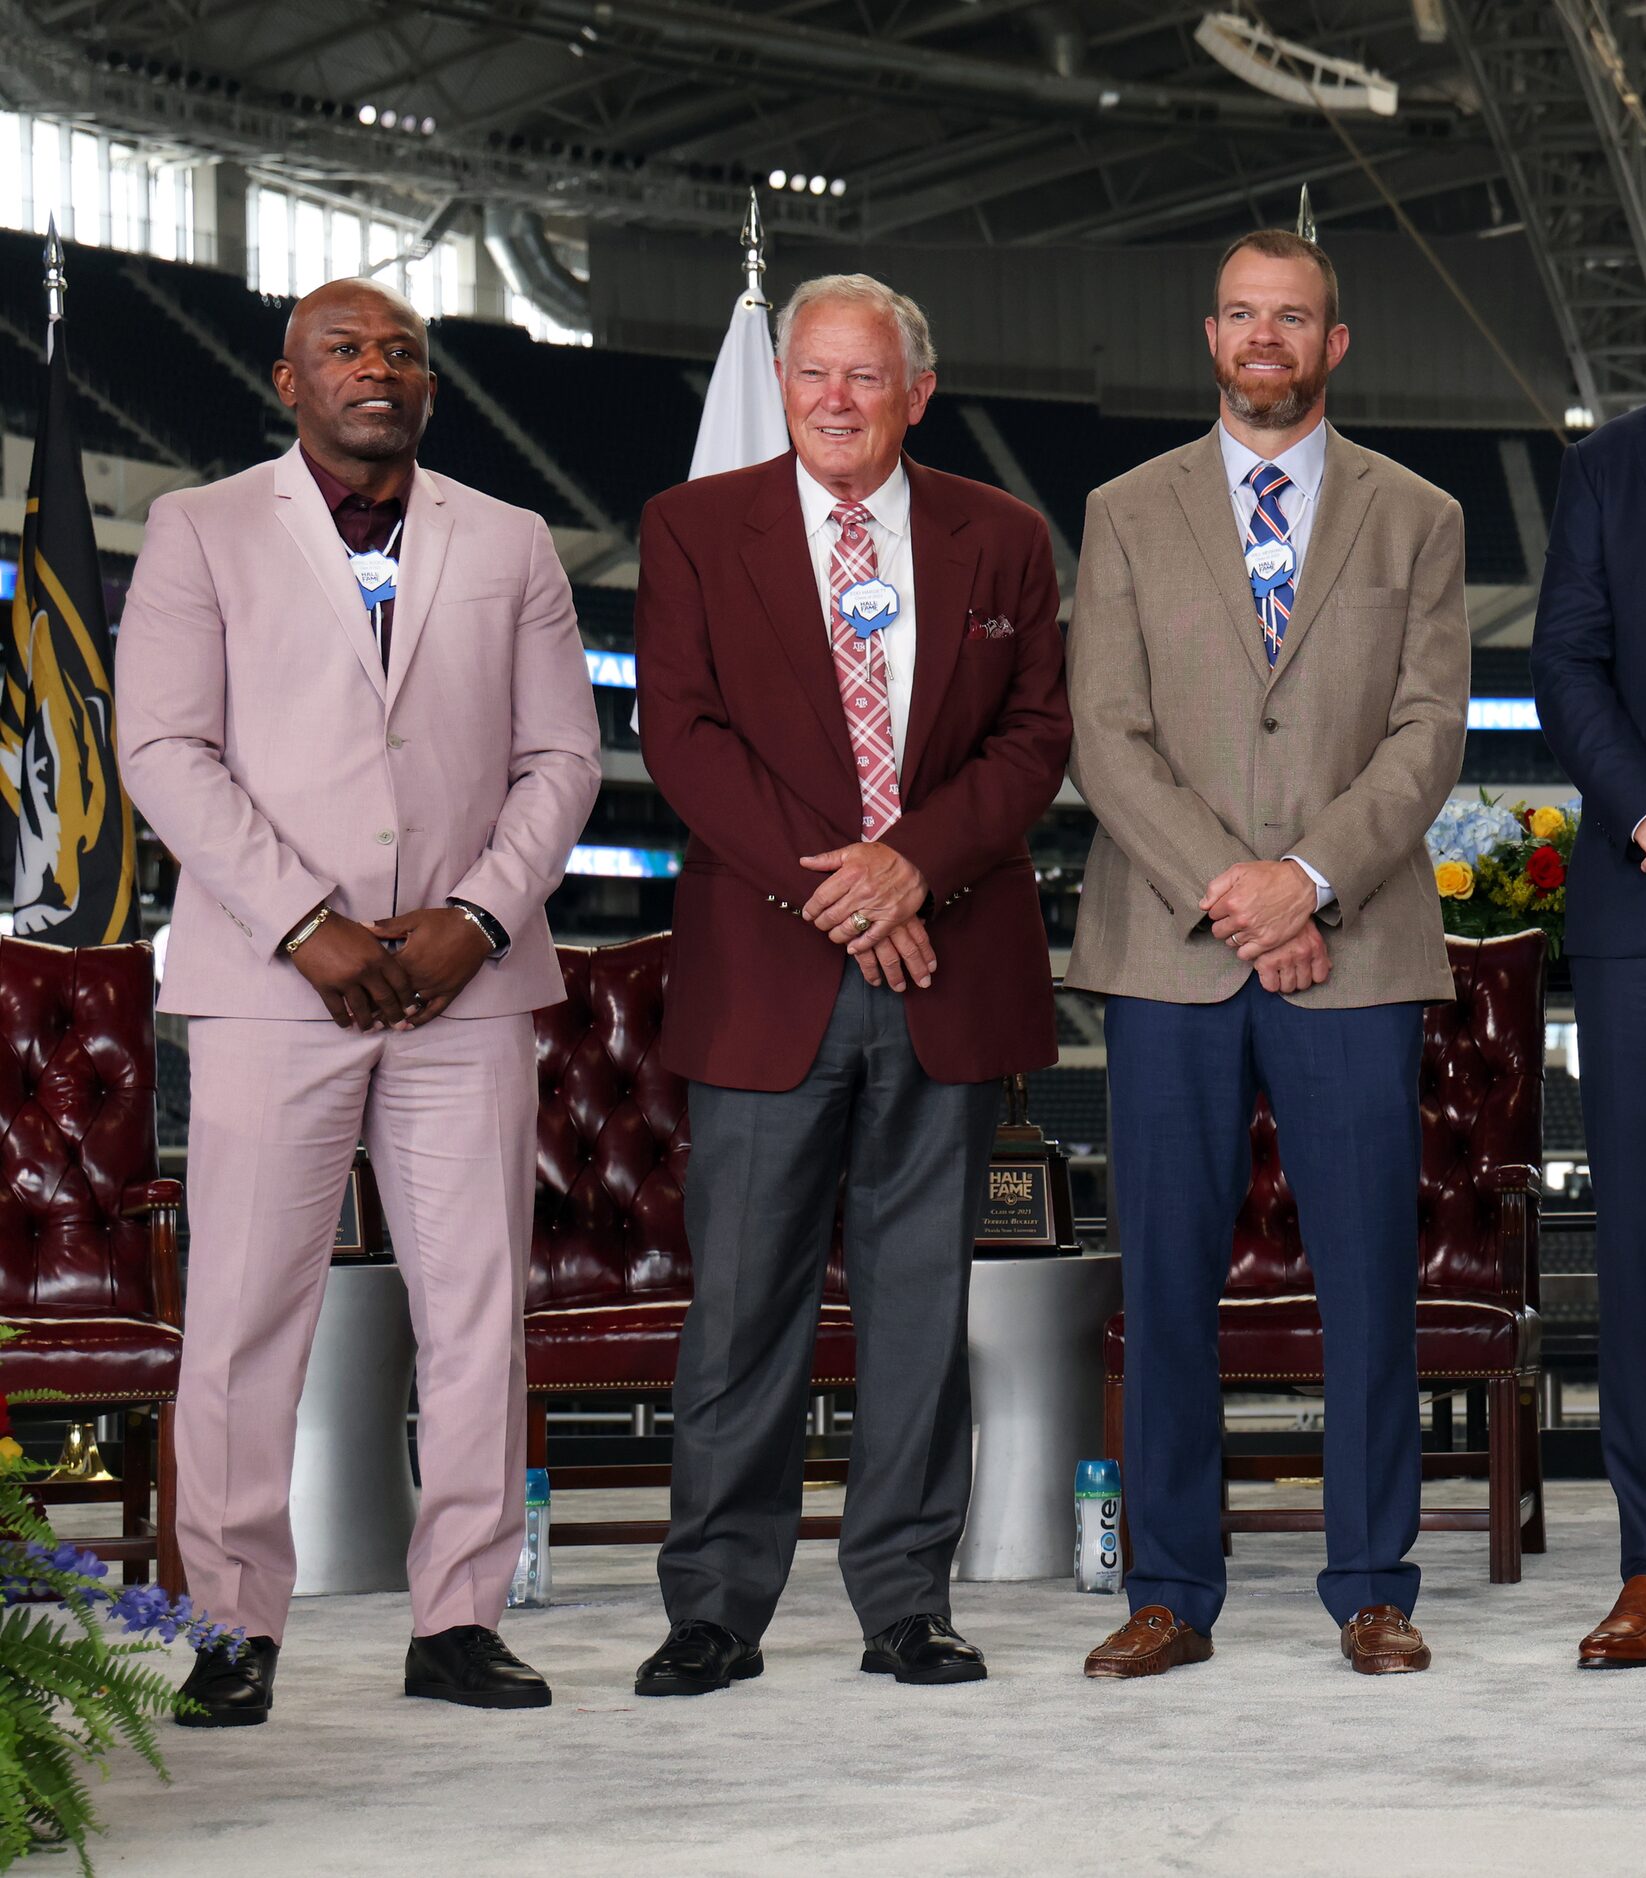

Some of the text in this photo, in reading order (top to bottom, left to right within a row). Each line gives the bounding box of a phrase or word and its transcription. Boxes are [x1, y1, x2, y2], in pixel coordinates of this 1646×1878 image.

[989, 1171, 1033, 1184] HALL
[989, 1183, 1033, 1200] FAME
[1100, 1499, 1117, 1569] core
